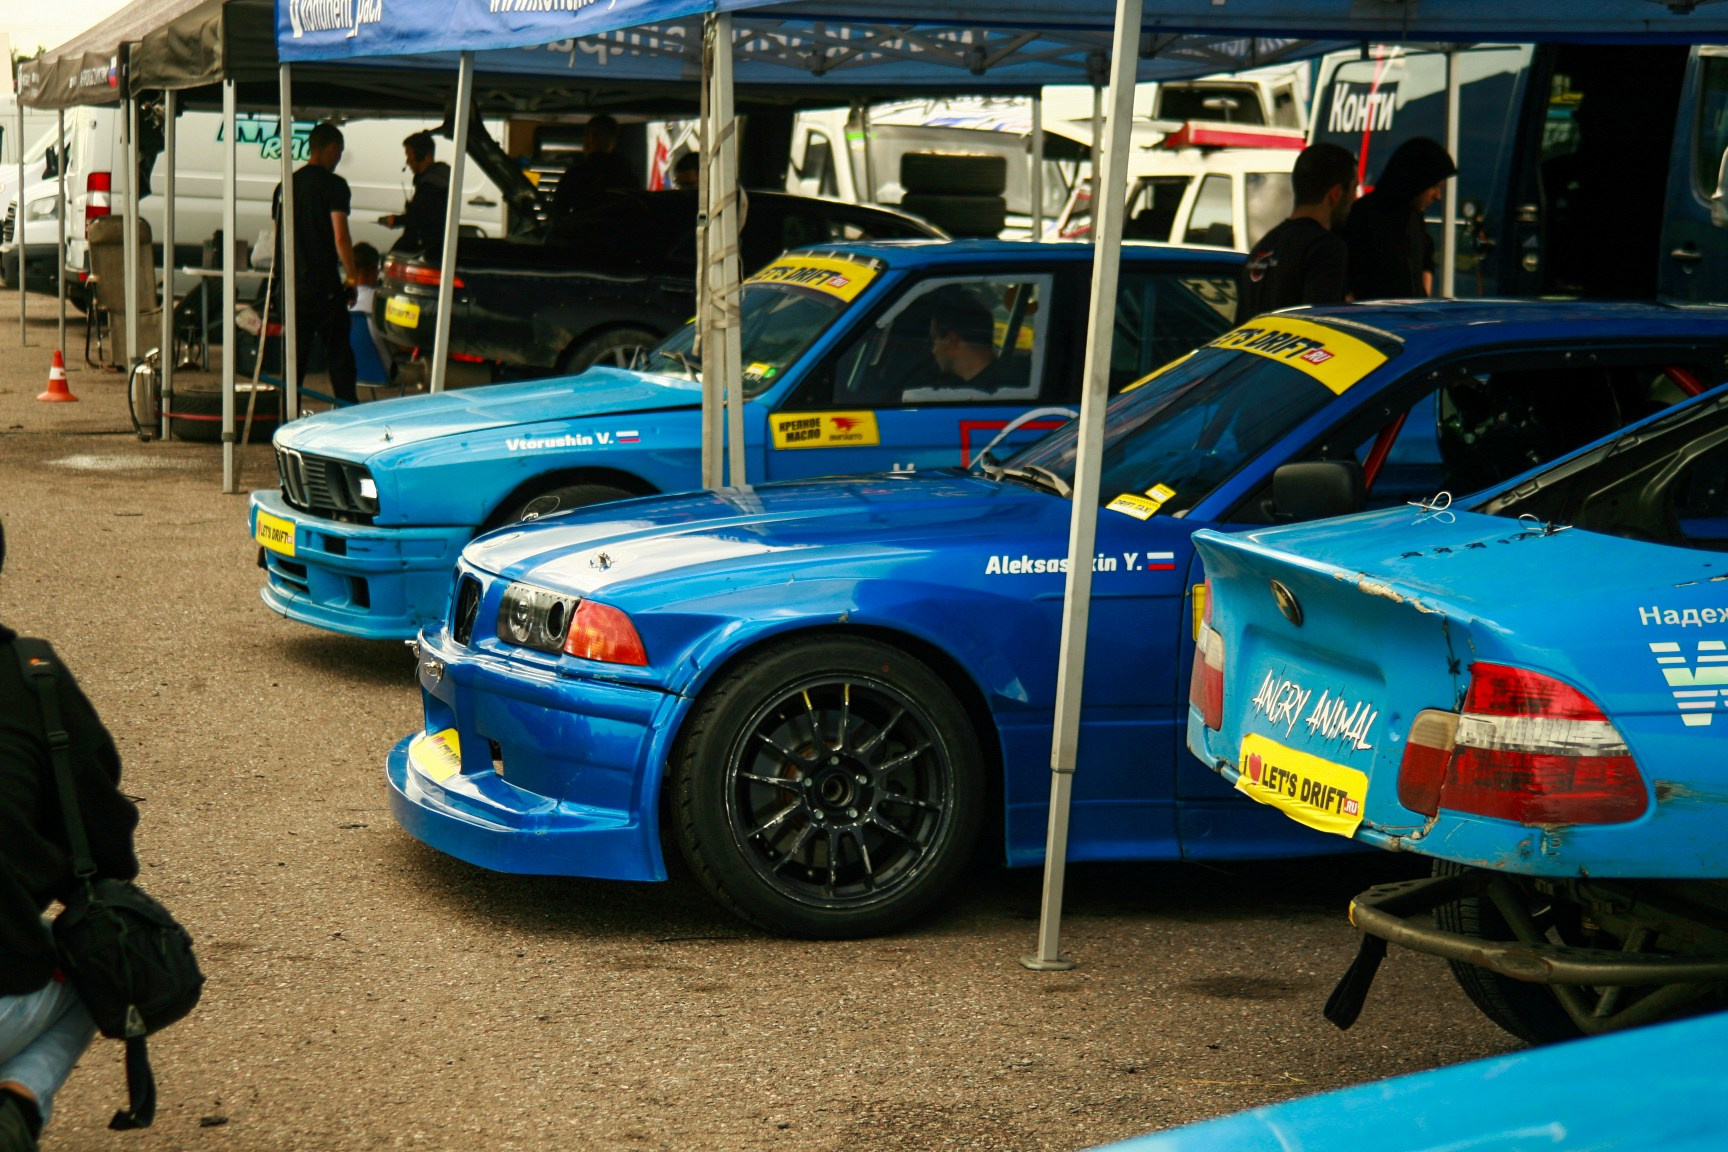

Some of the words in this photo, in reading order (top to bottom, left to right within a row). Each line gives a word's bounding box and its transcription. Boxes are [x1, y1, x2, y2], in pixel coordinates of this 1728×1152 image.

[1328, 83, 1396, 132] Конти
[506, 434, 593, 451] Vtorushin
[595, 431, 614, 445] V.
[786, 429, 820, 443] МАСЛО
[1123, 552, 1142, 571] Y.
[1252, 667, 1312, 740] ANGRY
[1304, 688, 1378, 751] ANIMAL
[1261, 763, 1298, 798] LET'S
